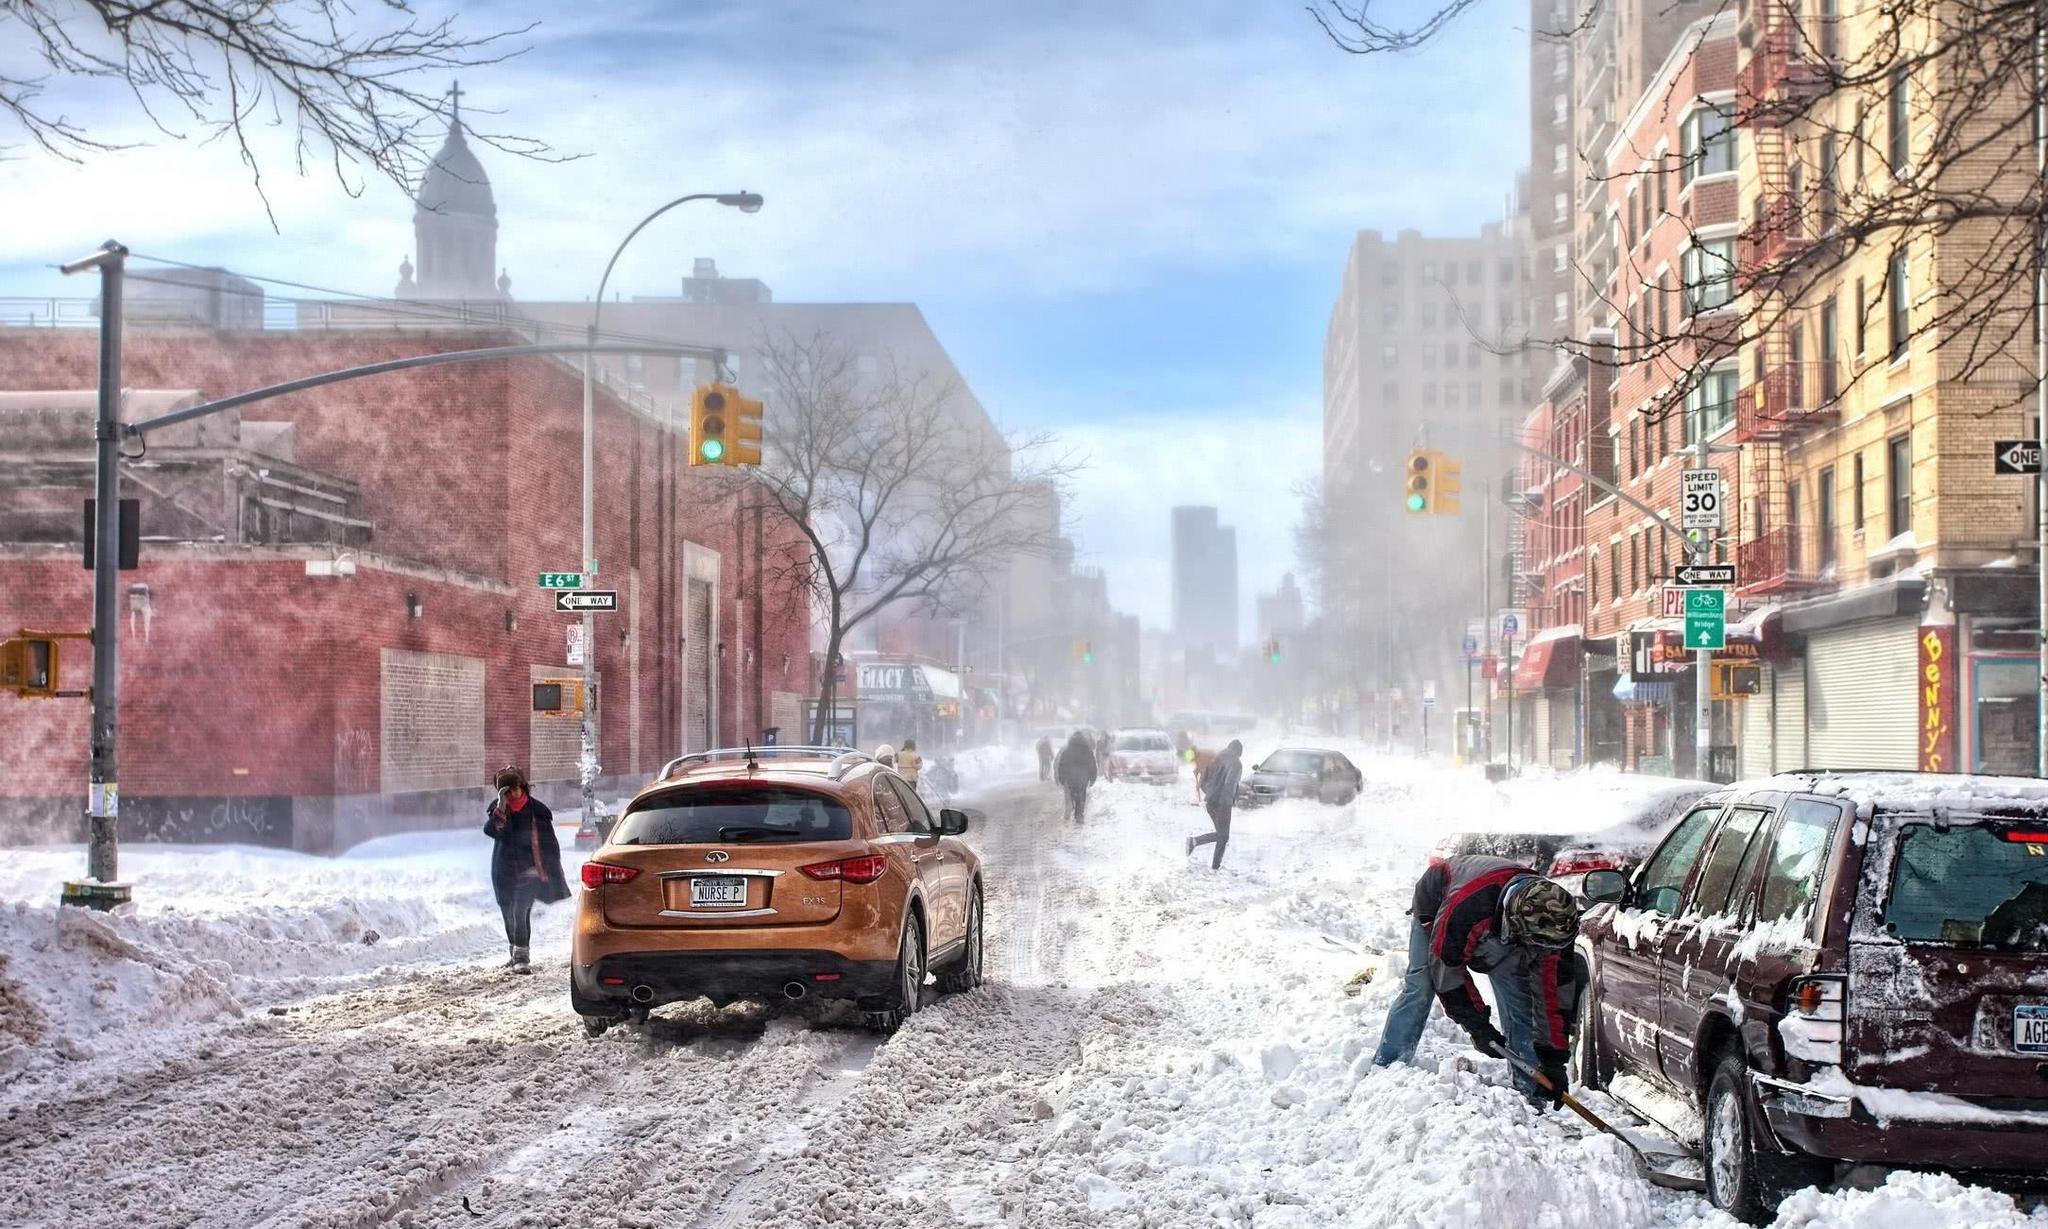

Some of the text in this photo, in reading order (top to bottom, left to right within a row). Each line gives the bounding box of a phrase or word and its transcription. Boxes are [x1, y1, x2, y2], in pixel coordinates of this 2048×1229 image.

[2010, 450, 2040, 464] ONE
[1684, 473, 1718, 482] SPEED
[1688, 483, 1713, 492] LIMIT
[1686, 493, 1716, 512] 30
[1684, 571, 1728, 580] ONE WAY
[545, 574, 554, 587] E
[555, 575, 565, 587] 6
[565, 597, 609, 605] ONE WAY
[1694, 620, 1715, 629] Bridge
[698, 886, 740, 900] NURSE P
